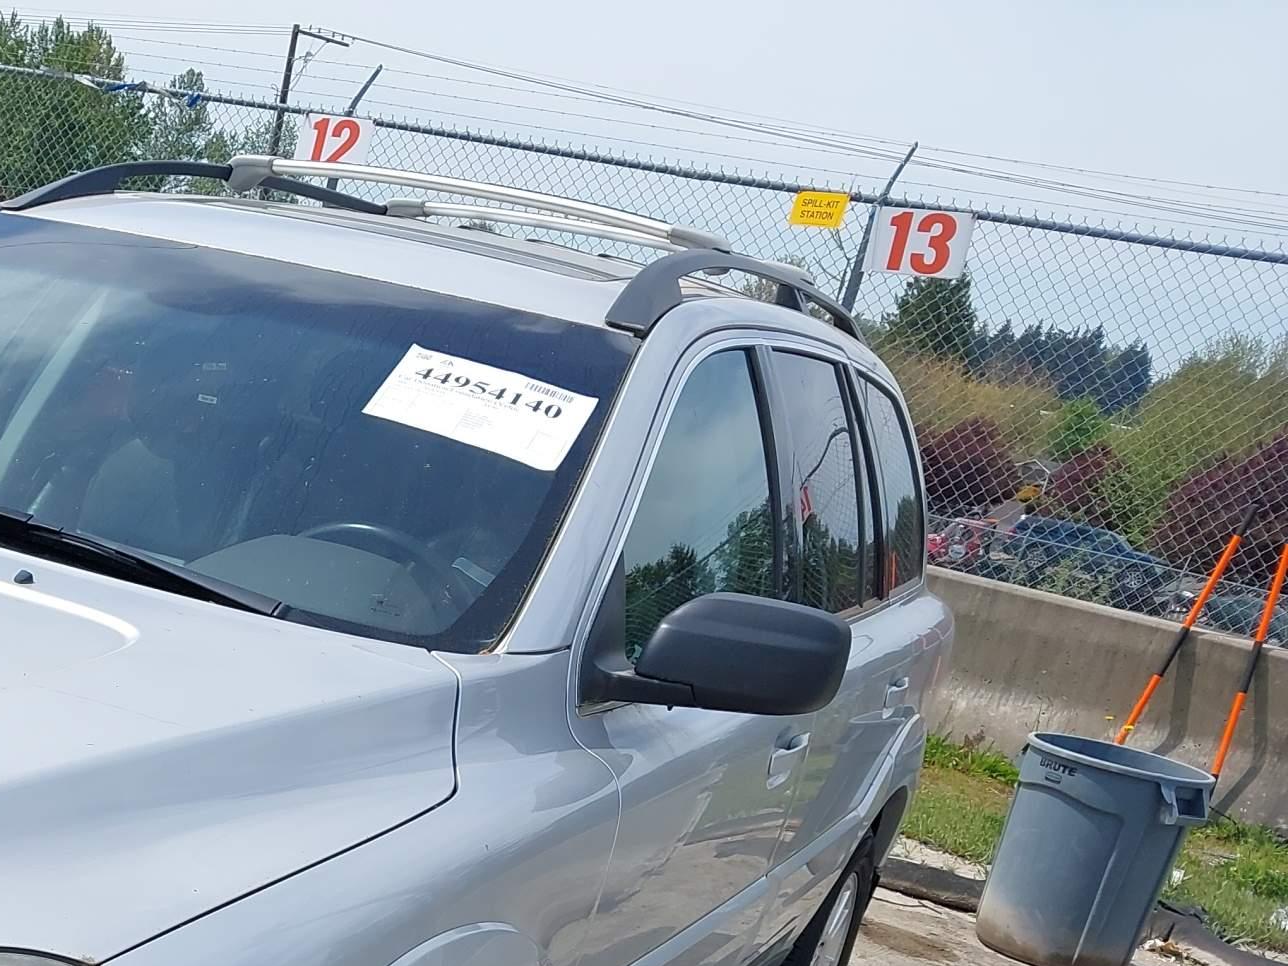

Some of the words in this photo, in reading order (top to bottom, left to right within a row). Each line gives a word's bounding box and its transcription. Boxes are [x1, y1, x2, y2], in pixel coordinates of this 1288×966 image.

[311, 117, 360, 163] 12
[799, 209, 834, 220] STATION
[801, 197, 840, 209] SPILL-KIT
[886, 210, 958, 275] 13
[415, 367, 562, 419] 44954140
[1039, 756, 1078, 777] BRUTE
